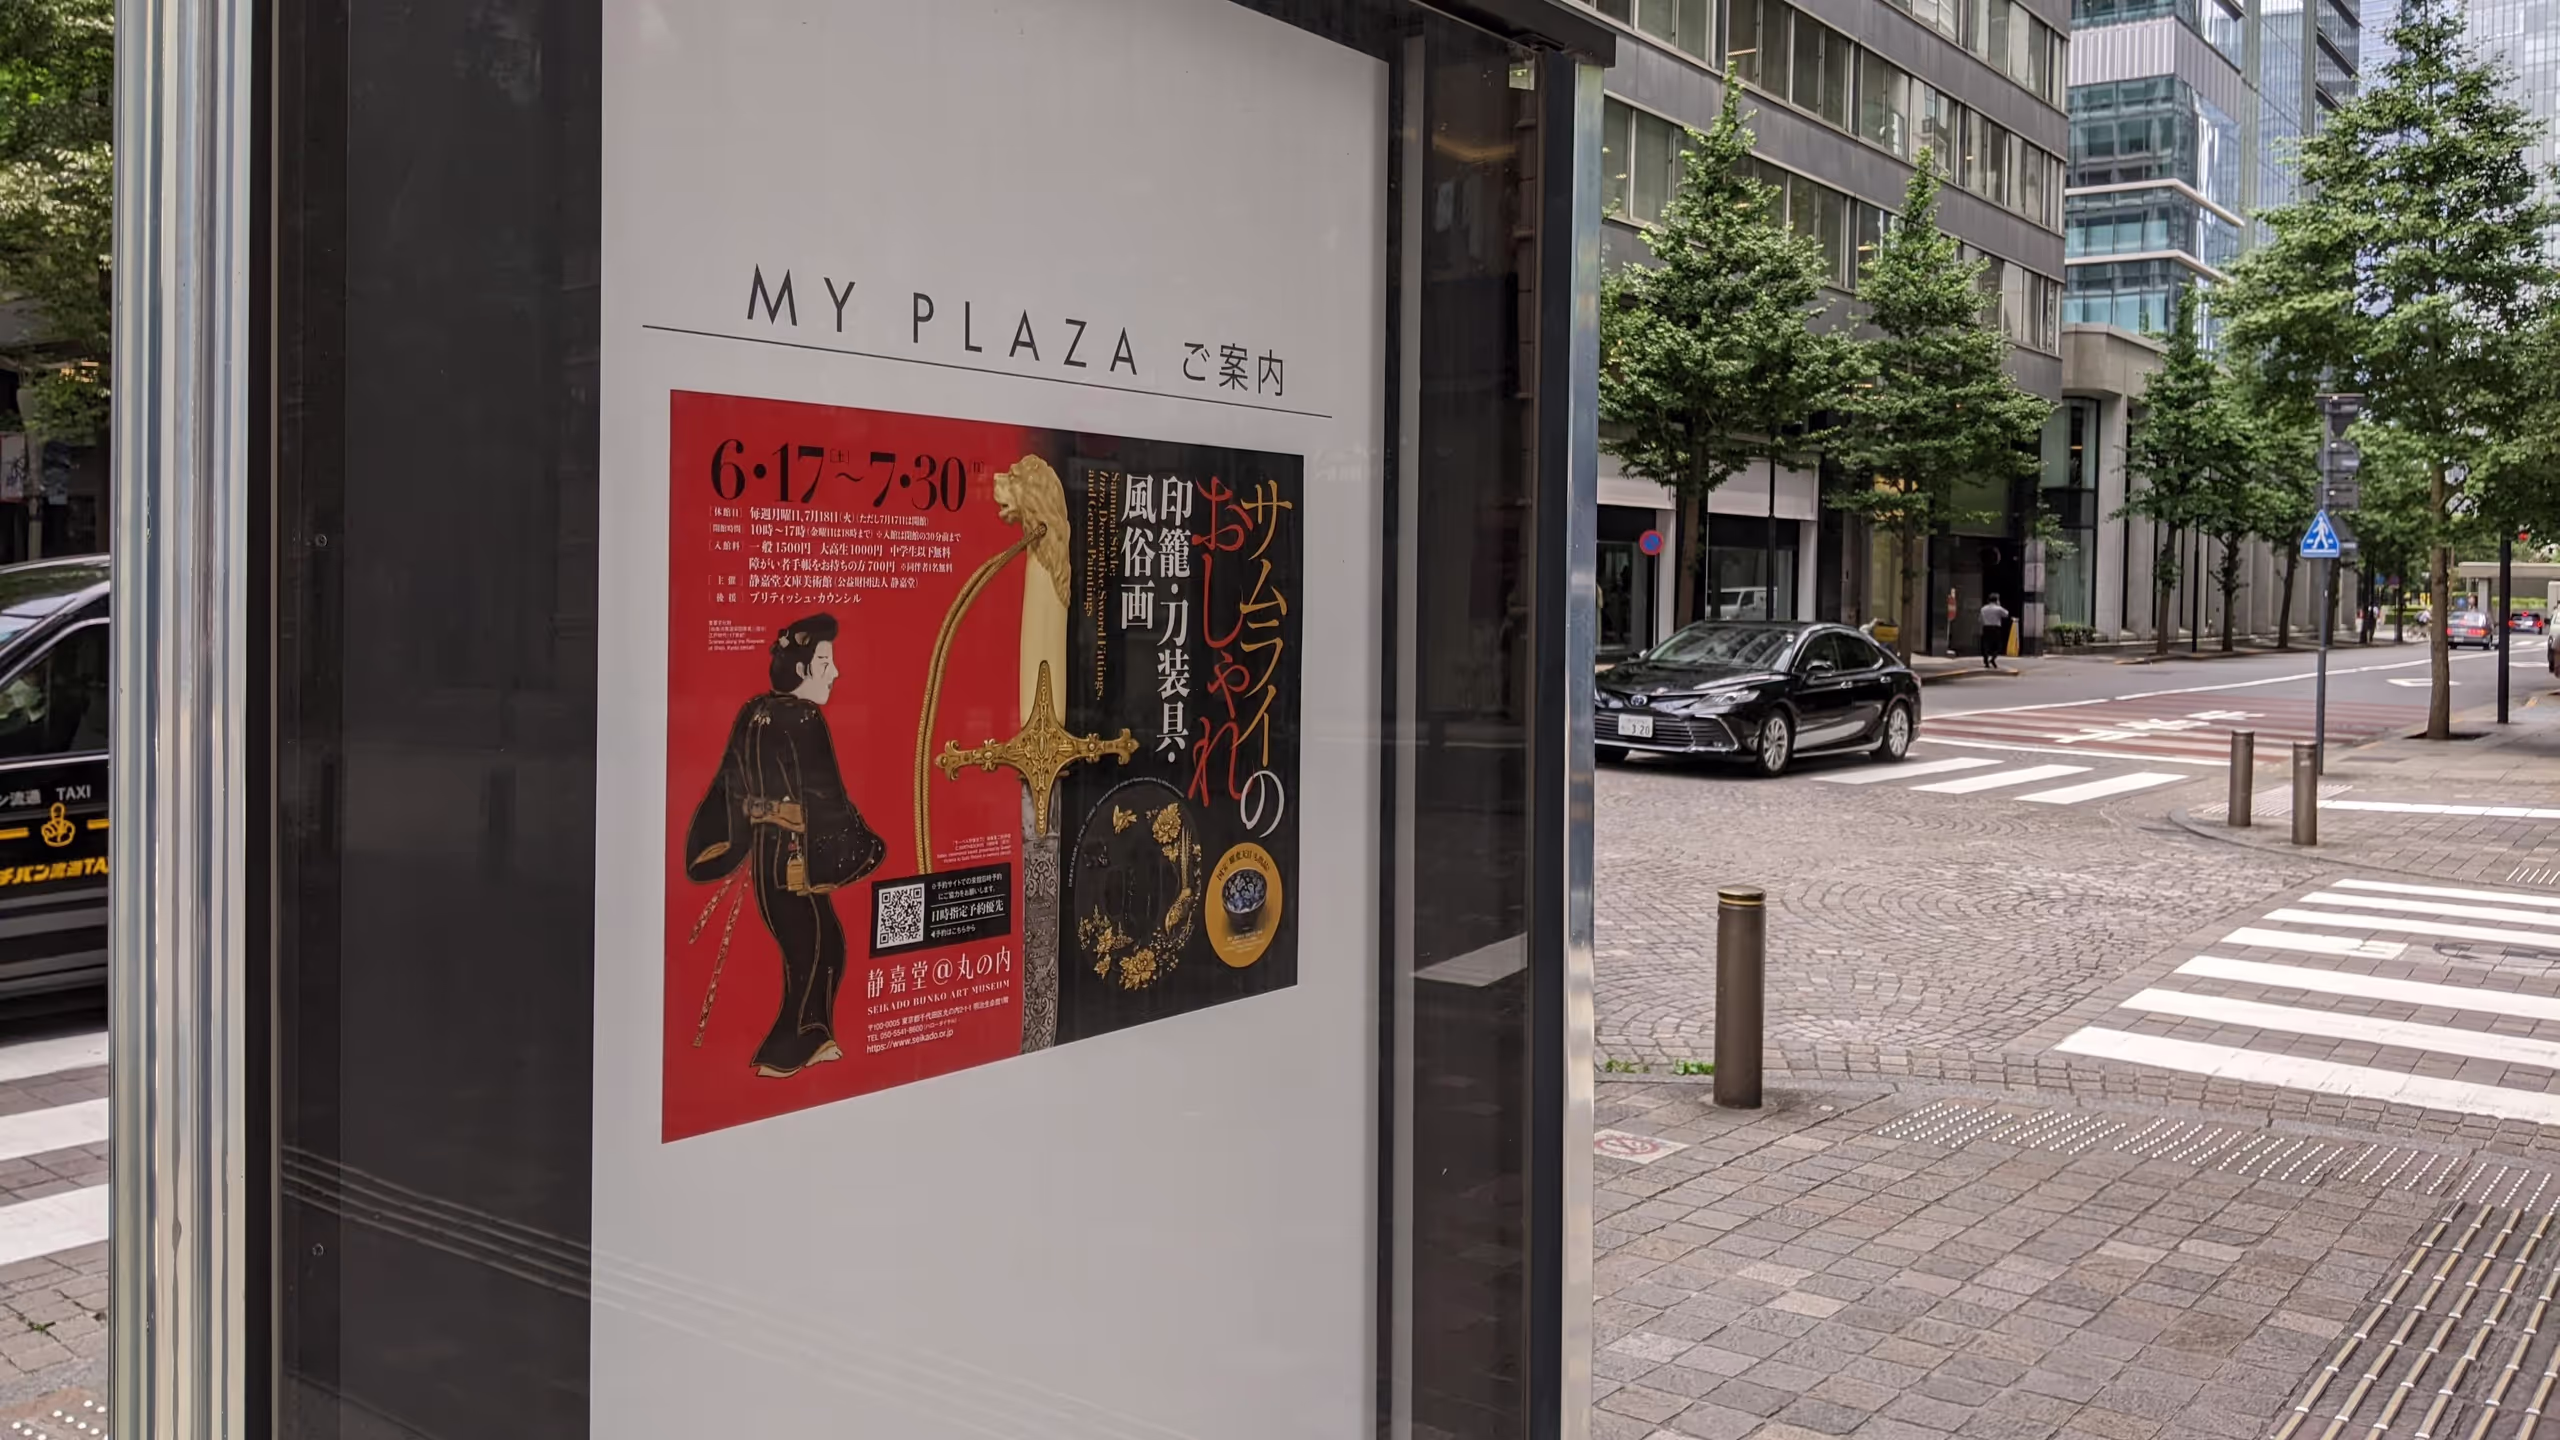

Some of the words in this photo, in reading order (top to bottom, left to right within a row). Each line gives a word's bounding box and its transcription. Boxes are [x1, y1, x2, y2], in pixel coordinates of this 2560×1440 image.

[747, 263, 855, 332] MY
[912, 292, 1137, 375] PLAZA
[1182, 341, 1284, 397] ご案内
[1087, 469, 1097, 497] and
[1109, 471, 1120, 533] Samurai
[1087, 500, 1097, 546] Genre
[776, 541, 811, 555] 1500円
[890, 545, 951, 559] 中学生以下無料
[1098, 510, 1107, 588] Decorative
[1121, 473, 1157, 630] 風俗画
[750, 592, 861, 604] ブリティッシュ・カウンシル
[1083, 549, 1097, 617] Paintings
[1097, 590, 1107, 636] Sword
[1188, 475, 1255, 807] おしゃれ
[1232, 479, 1293, 838] サムライの
[56, 784, 91, 801] TAXI
[931, 899, 1004, 923] 日時指定予約優先
[867, 946, 1011, 999] 静嘉堂@丸の内
[867, 999, 911, 1016] SEIKADO
[913, 993, 947, 1006] BUNKO
[950, 987, 969, 999] ART
[972, 979, 1010, 994] MUSEUM
[866, 1027, 954, 1055] https://www.seikado.or.jp
[867, 1034, 879, 1043] TEL
